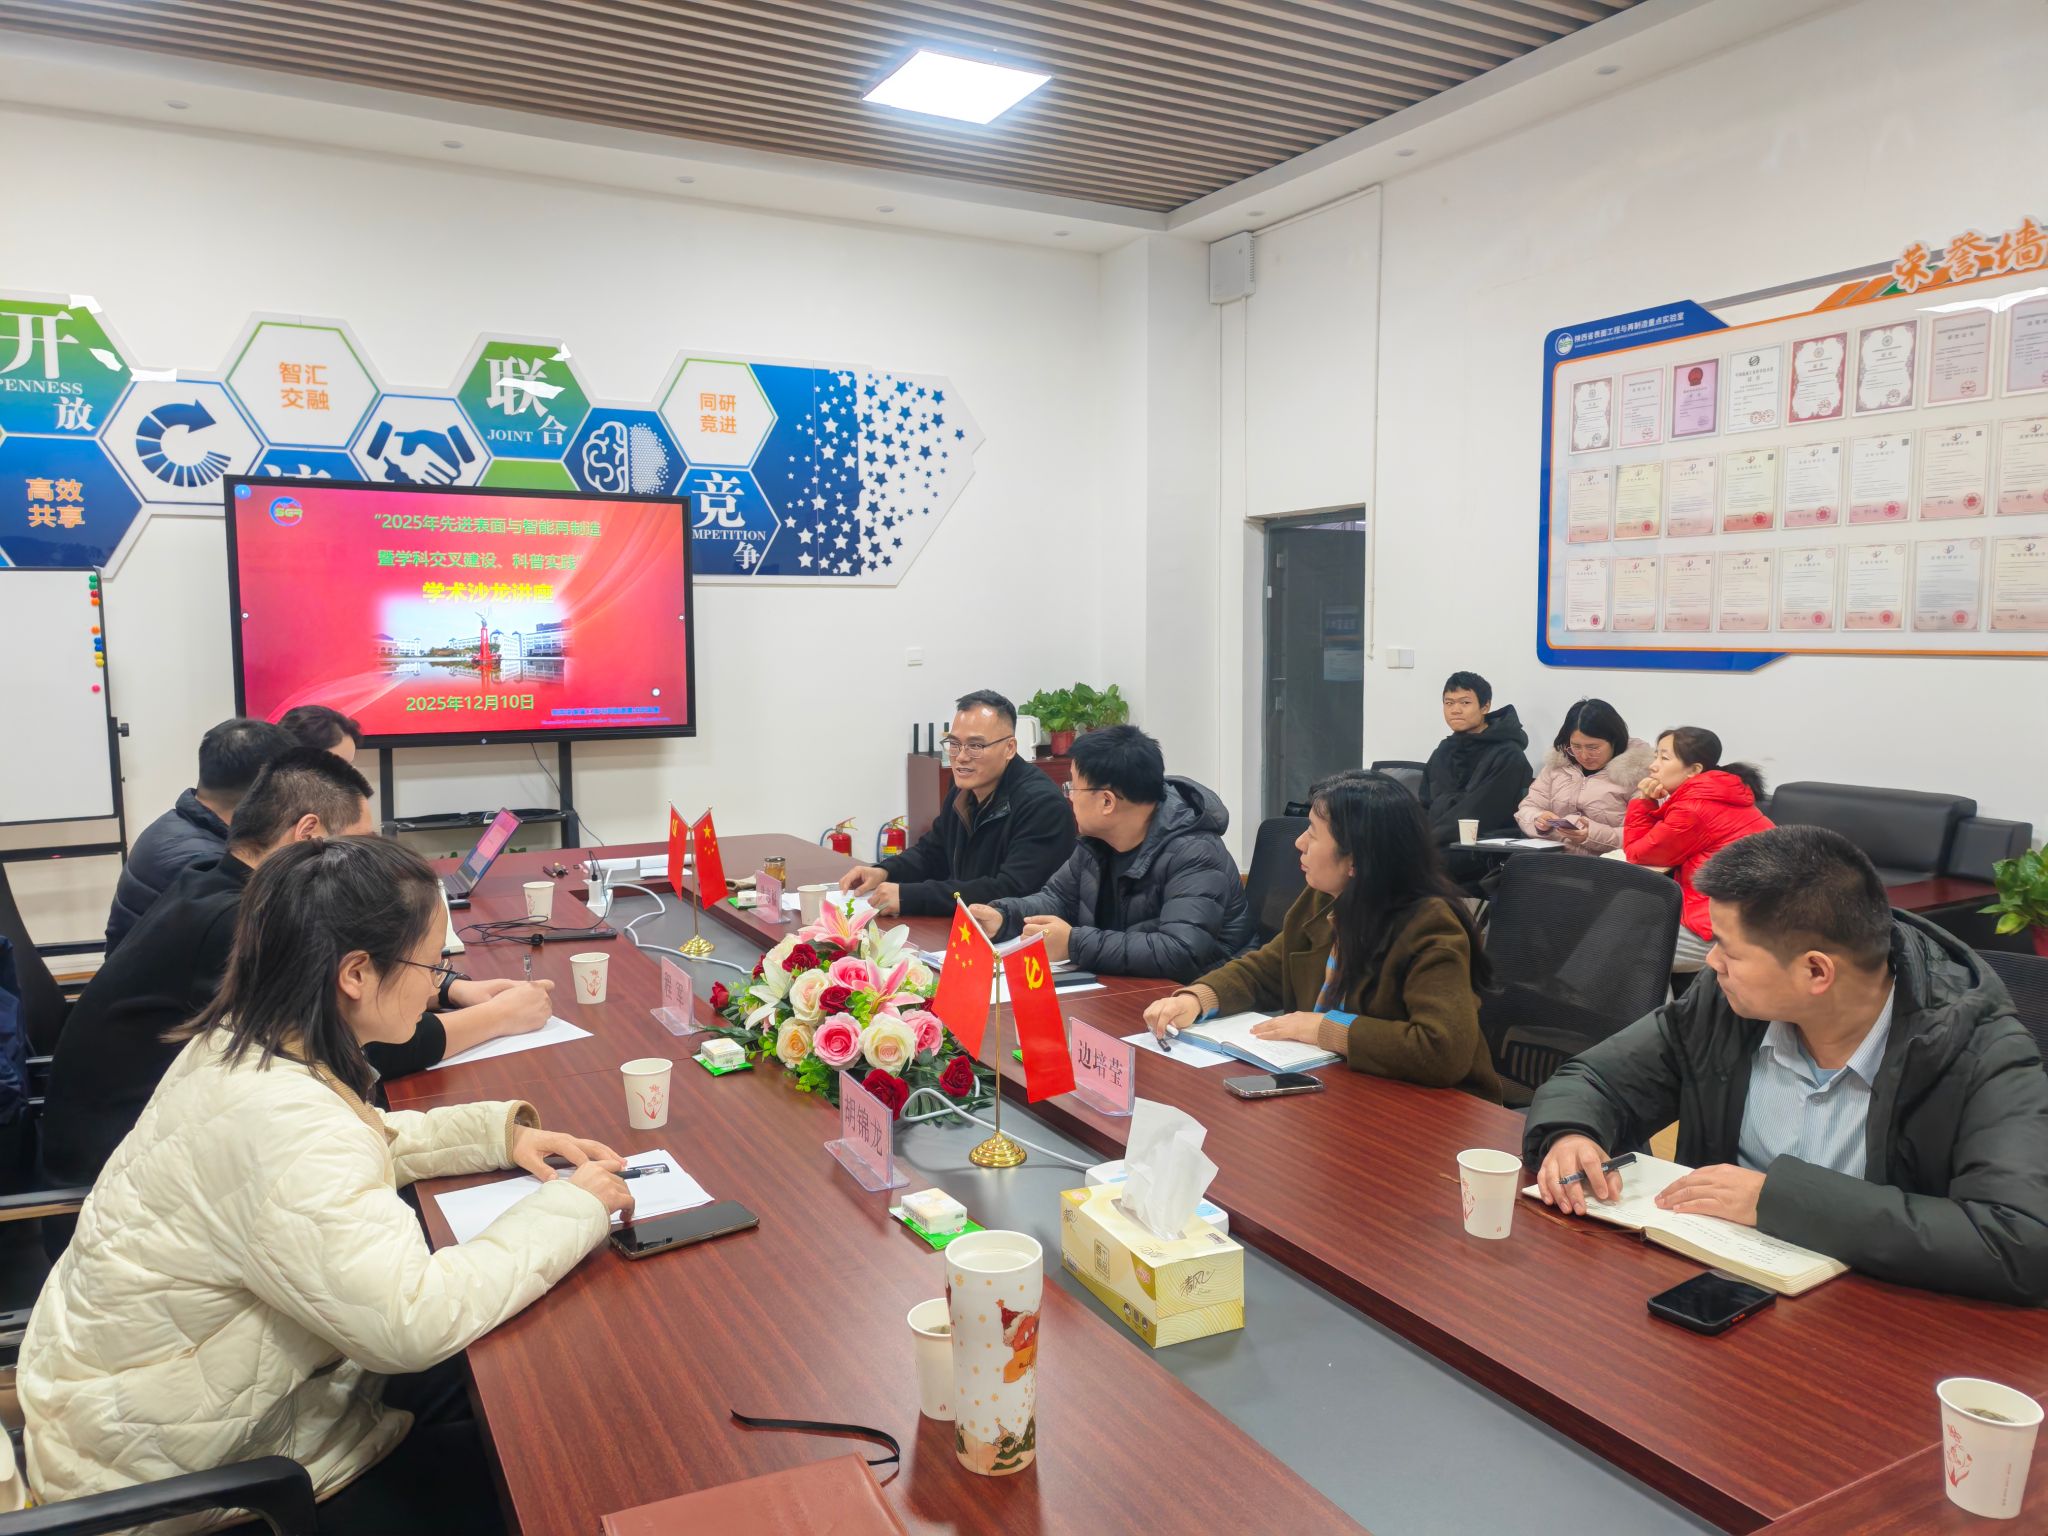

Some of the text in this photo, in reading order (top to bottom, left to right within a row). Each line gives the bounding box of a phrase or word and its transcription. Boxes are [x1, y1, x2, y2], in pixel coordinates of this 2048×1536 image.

[1895, 218, 2048, 289] 荣誉墙
[0, 311, 79, 379] 开
[279, 362, 328, 385] 智汇
[485, 356, 548, 417] 联
[281, 387, 330, 411] 交融
[700, 393, 736, 411] 同研
[53, 396, 96, 431] 放
[700, 415, 736, 433] 竞进
[487, 429, 533, 442] JOINT
[538, 415, 568, 445] 合
[26, 477, 84, 501] 高效
[691, 471, 746, 528] 竞
[28, 504, 86, 528] 共享
[733, 541, 760, 569] 争
[422, 581, 554, 604] 学术沙龙讲座
[405, 694, 534, 712] 2025年12月10日
[1078, 1039, 1123, 1088] 边培莹
[844, 1094, 883, 1157] 胡锦龙
